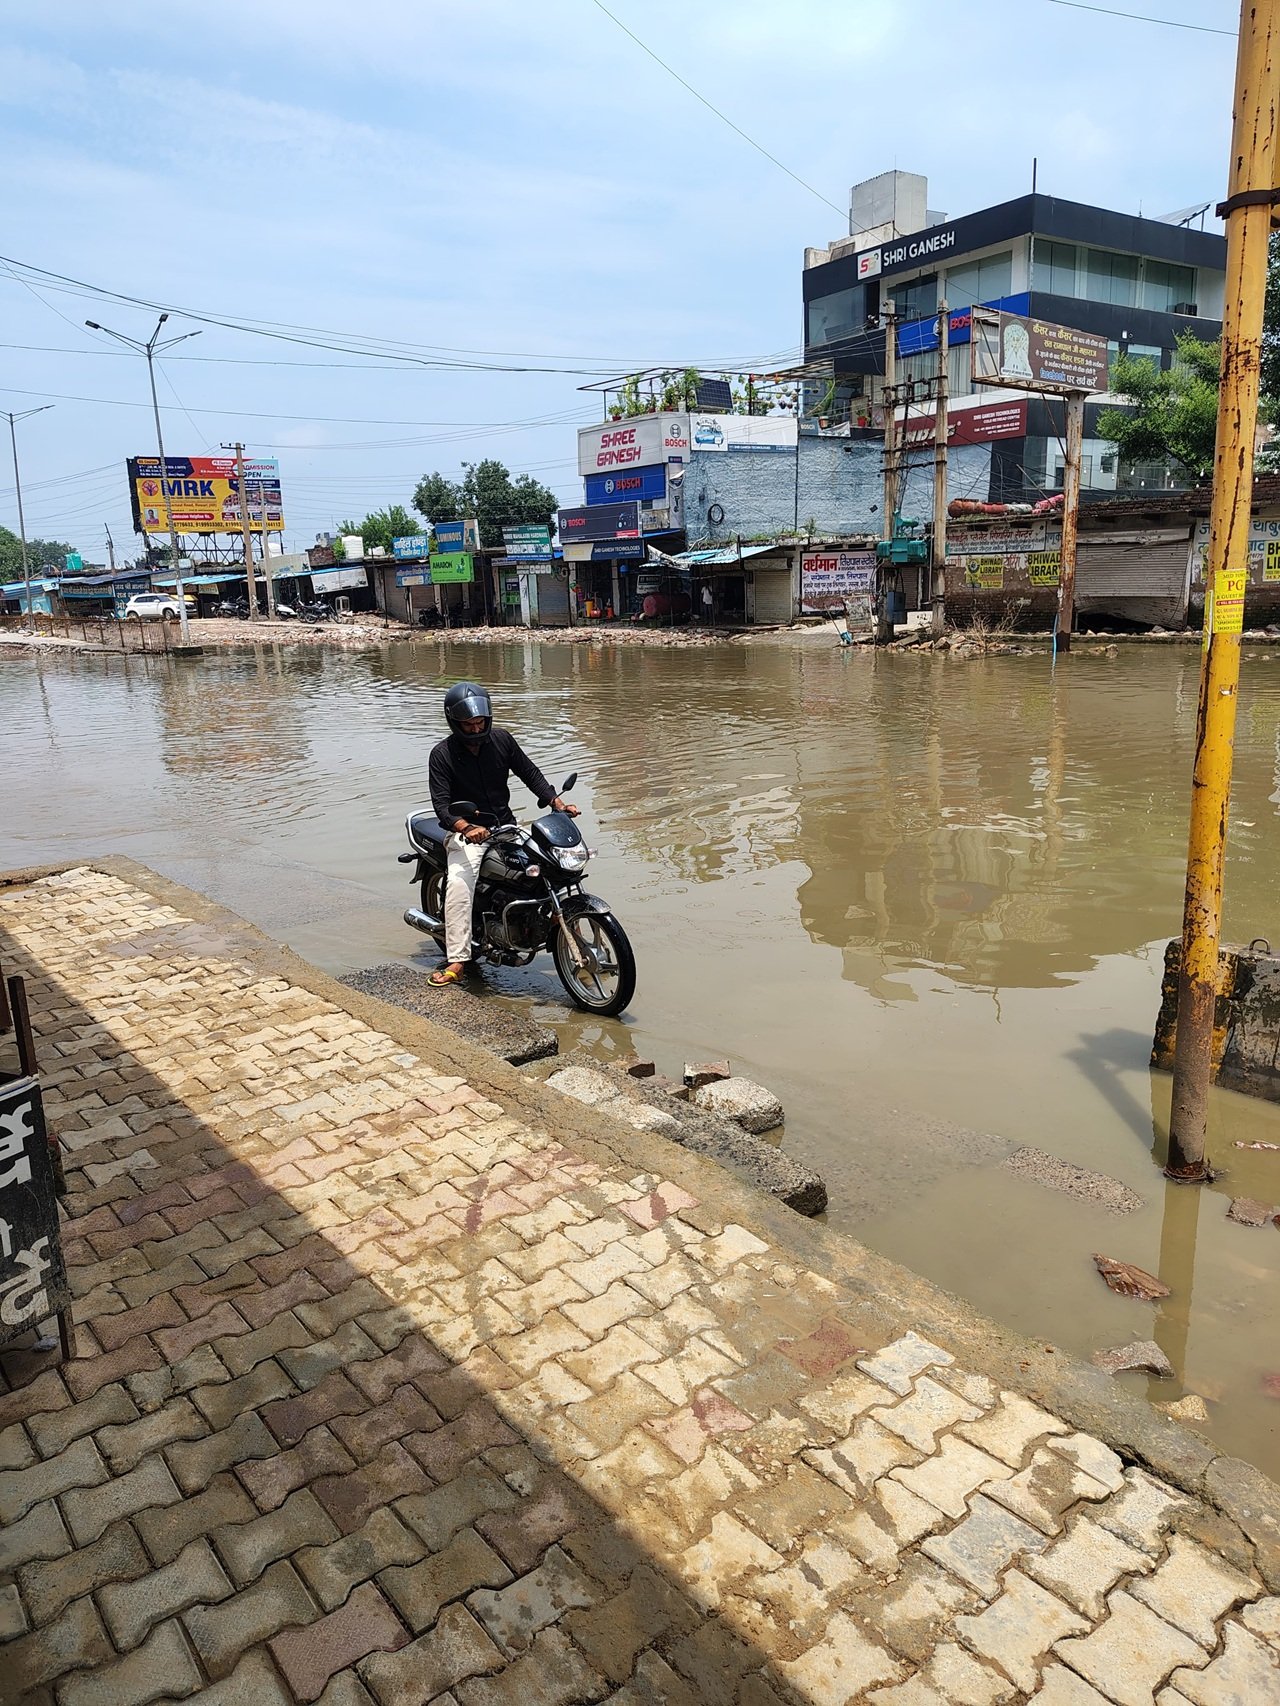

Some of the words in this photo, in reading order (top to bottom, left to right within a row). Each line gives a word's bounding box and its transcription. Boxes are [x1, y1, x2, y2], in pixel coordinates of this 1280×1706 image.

[883, 246, 907, 267] SHRI
[909, 231, 955, 258] GANESH
[950, 314, 971, 330] BOS
[600, 428, 637, 449] SHREE
[664, 438, 687, 448] BOSCH
[597, 446, 642, 467] GANESH
[161, 480, 215, 496] MRK
[615, 477, 641, 490] BOSCH
[568, 519, 586, 527] BOSCH
[437, 531, 462, 543] LUMINOUS
[803, 554, 838, 572] वर्धमान
[1027, 552, 1060, 564] BHIWAD
[432, 560, 453, 569] AMARON
[980, 566, 1002, 574] LIBRARY
[1227, 579, 1244, 591] PG
